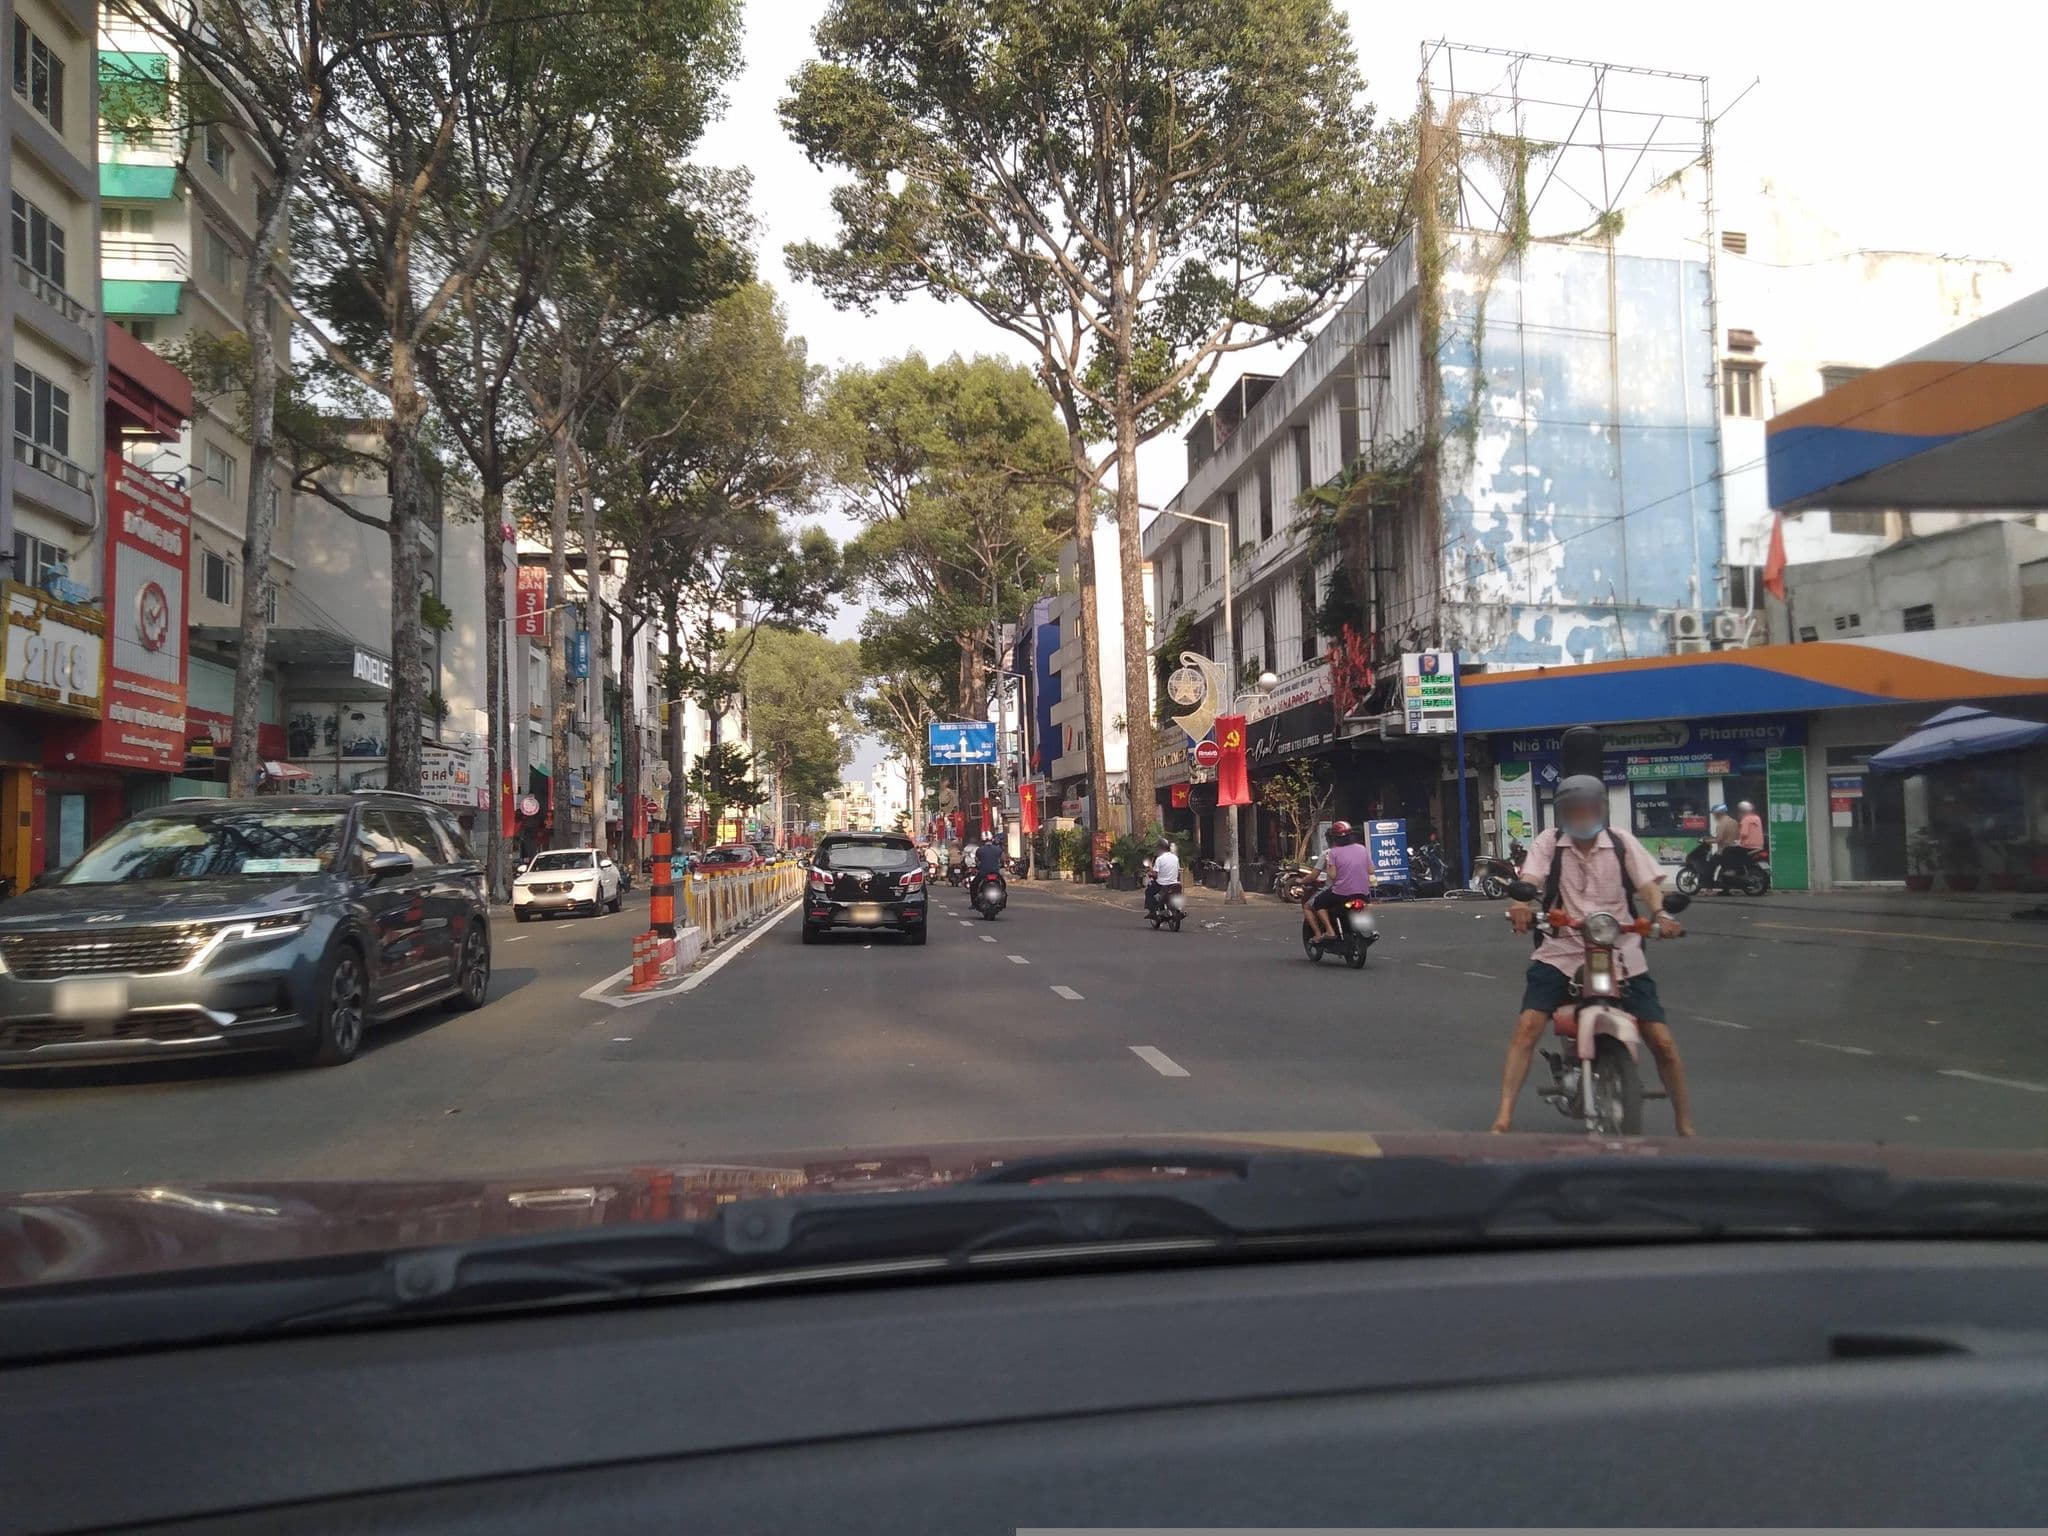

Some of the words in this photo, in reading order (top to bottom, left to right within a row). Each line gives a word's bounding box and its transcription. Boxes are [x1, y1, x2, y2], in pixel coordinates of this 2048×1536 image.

[1700, 725, 1786, 740] Pharmacy
[1378, 847, 1401, 857] THUỐC
[1378, 857, 1390, 867] GIÁ
[1390, 856, 1402, 866] TỐT
